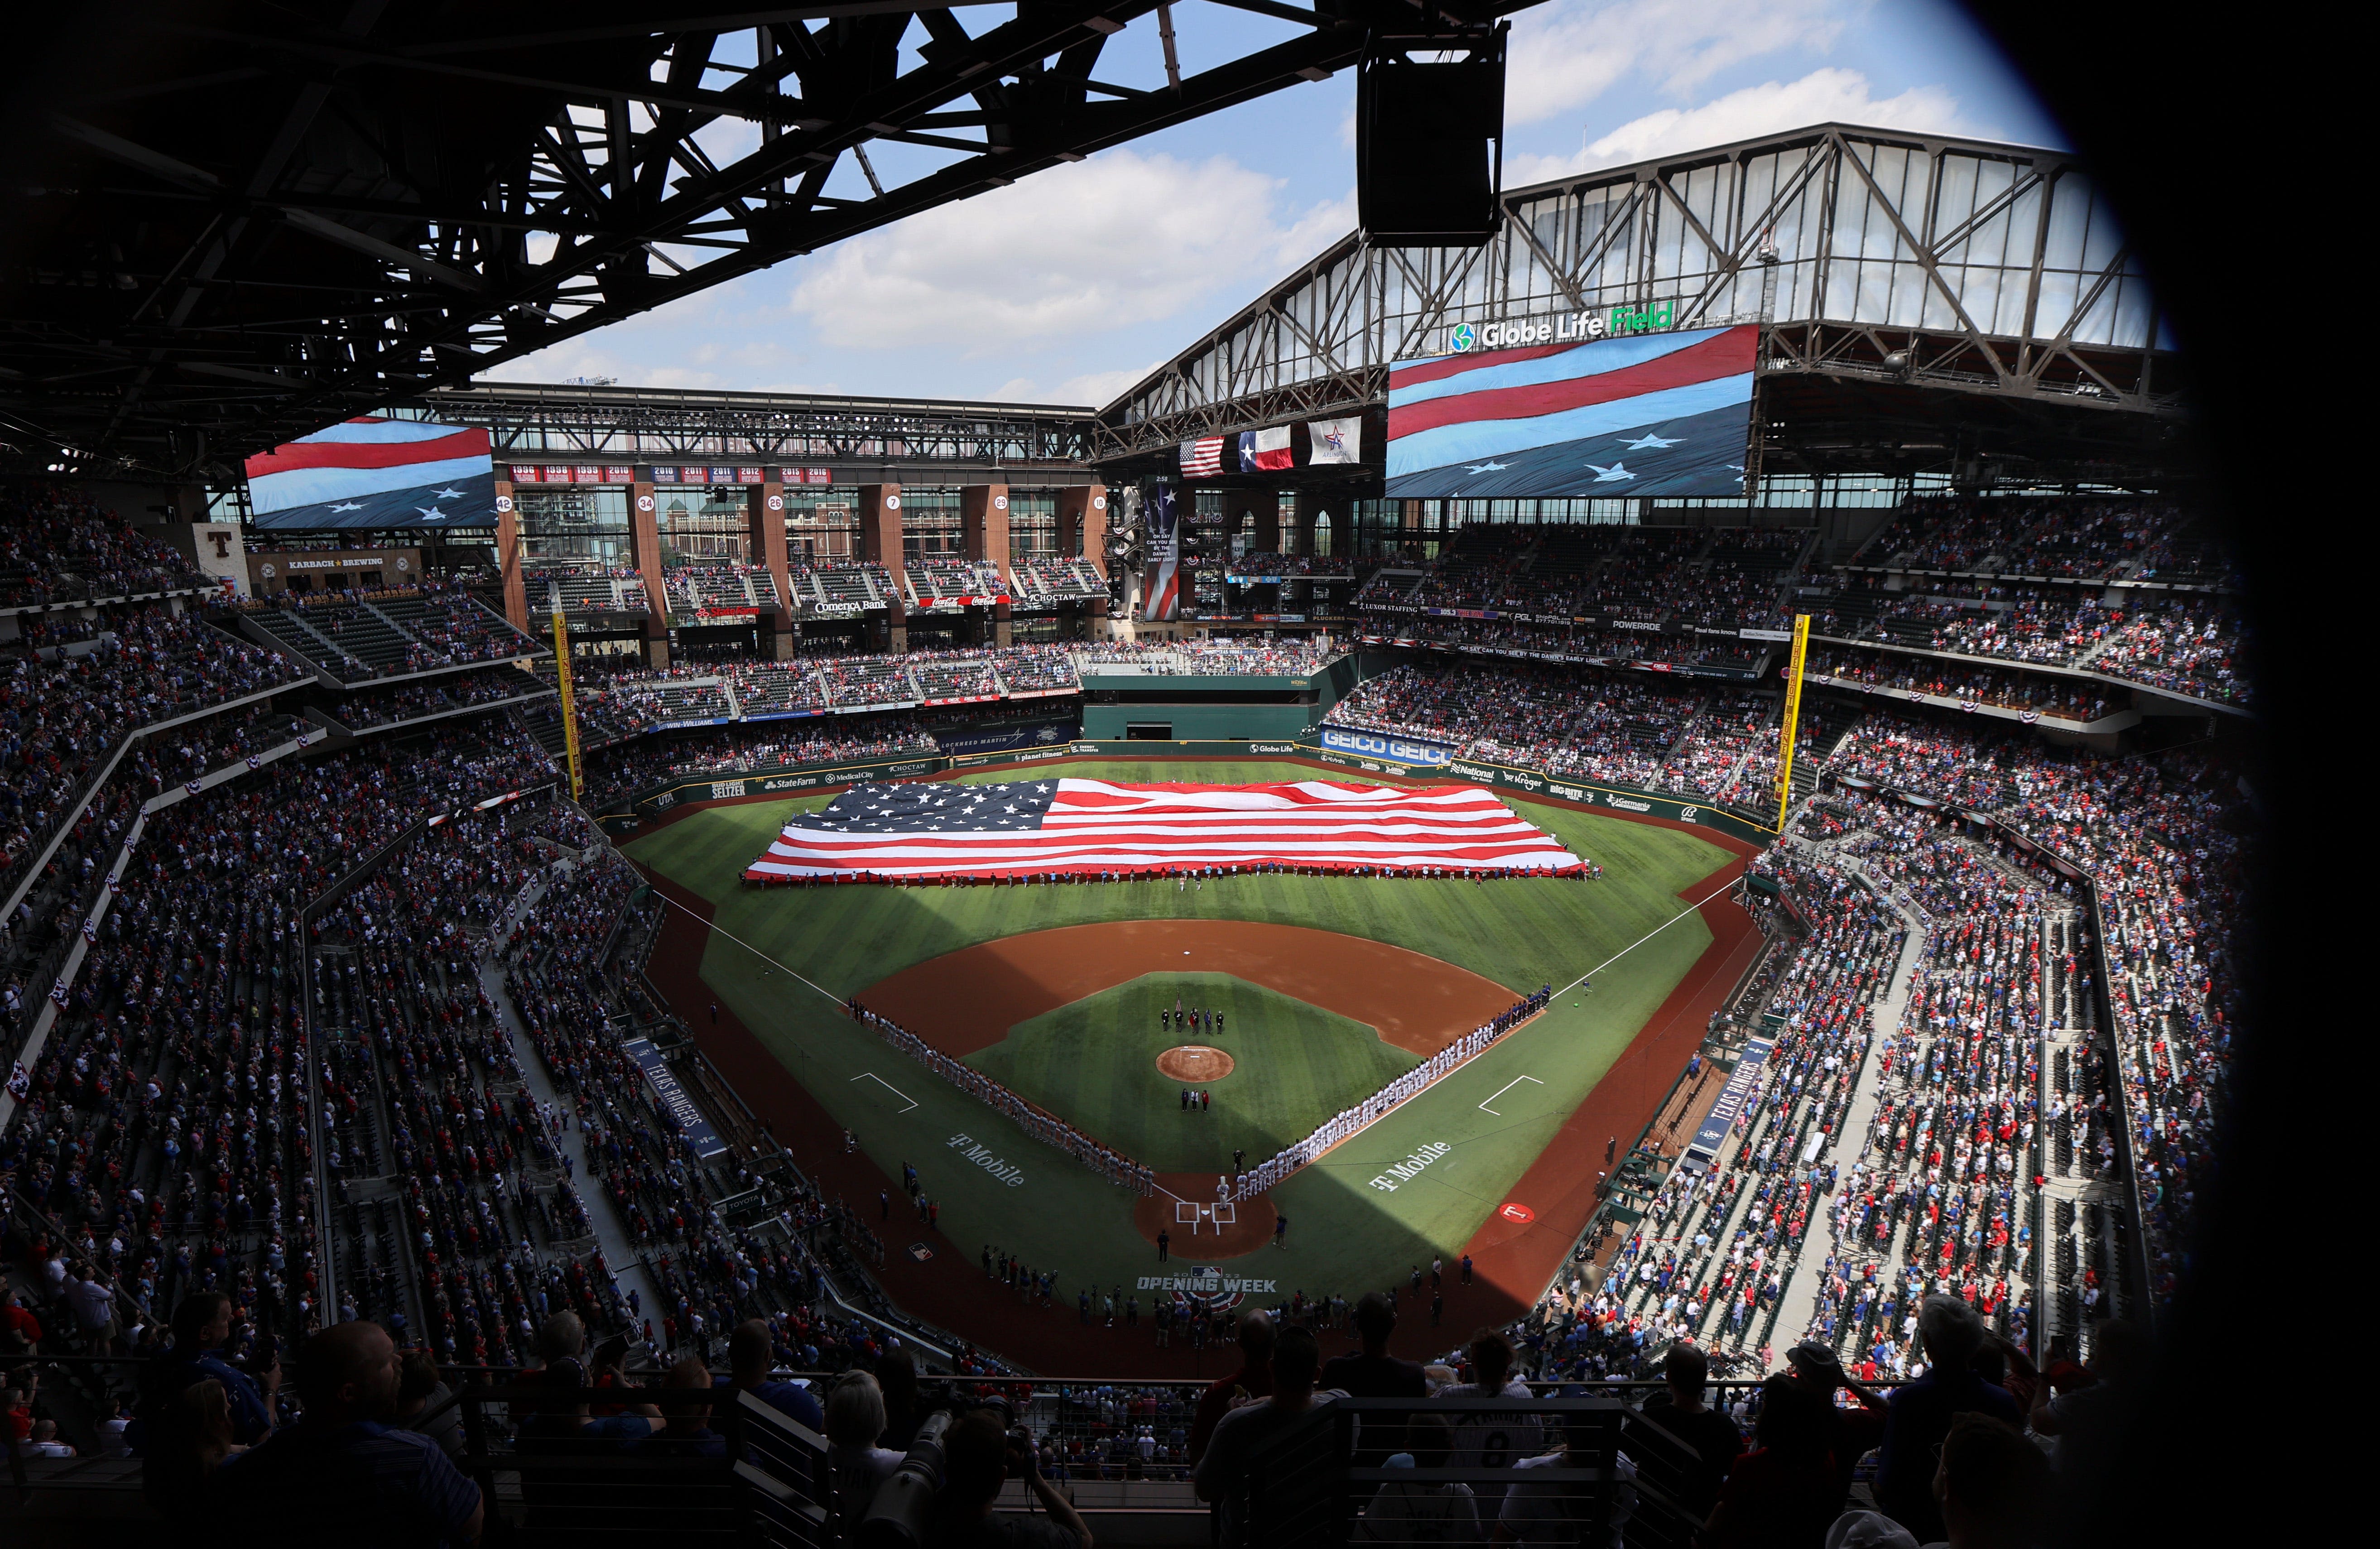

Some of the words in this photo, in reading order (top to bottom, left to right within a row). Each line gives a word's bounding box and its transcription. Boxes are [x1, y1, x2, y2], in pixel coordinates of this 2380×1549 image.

[1482, 320, 1552, 346] Globe
[1558, 311, 1604, 338] Life
[1611, 301, 1673, 332] Field
[498, 500, 510, 508] 42
[207, 531, 231, 557] T
[289, 560, 334, 568] KARBACH
[342, 558, 383, 567] BREWING
[1029, 593, 1076, 601] CHOCTAW
[710, 608, 735, 617] State
[733, 606, 760, 615] Farm
[862, 600, 887, 610] Bank
[1613, 621, 1661, 630] POWERADE
[560, 629, 570, 679] BRING
[569, 716, 578, 754] HEAT
[1787, 676, 1796, 706] HOT
[1782, 714, 1791, 753] ZONE
[942, 740, 977, 748] LOCKHEED
[1324, 729, 1386, 753] GEICO
[889, 764, 926, 772] CHOCTAW
[1460, 765, 1495, 779] National
[777, 779, 796, 788] State
[797, 778, 816, 786] Farm
[837, 773, 861, 781] Medical
[861, 772, 874, 780] City
[1515, 773, 1542, 790] Kroger
[712, 785, 745, 799] SELTZER
[1550, 785, 1564, 794] BIG
[1564, 788, 1583, 798] BITE
[658, 793, 673, 806] UTA
[1618, 799, 1651, 809] Germania
[646, 1063, 676, 1089] TEXAS
[664, 1089, 702, 1127] RANGERS
[1711, 1094, 1741, 1121] TEXAS
[1726, 1060, 1759, 1094] RANGERS
[960, 1143, 1024, 1187] Mobile
[1385, 1142, 1451, 1182] Mobile
[729, 1194, 759, 1209] TOYOTA
[1137, 1277, 1217, 1291] OPENING
[1223, 1279, 1276, 1292] WEEK
[1481, 1432, 1509, 1468] 8
